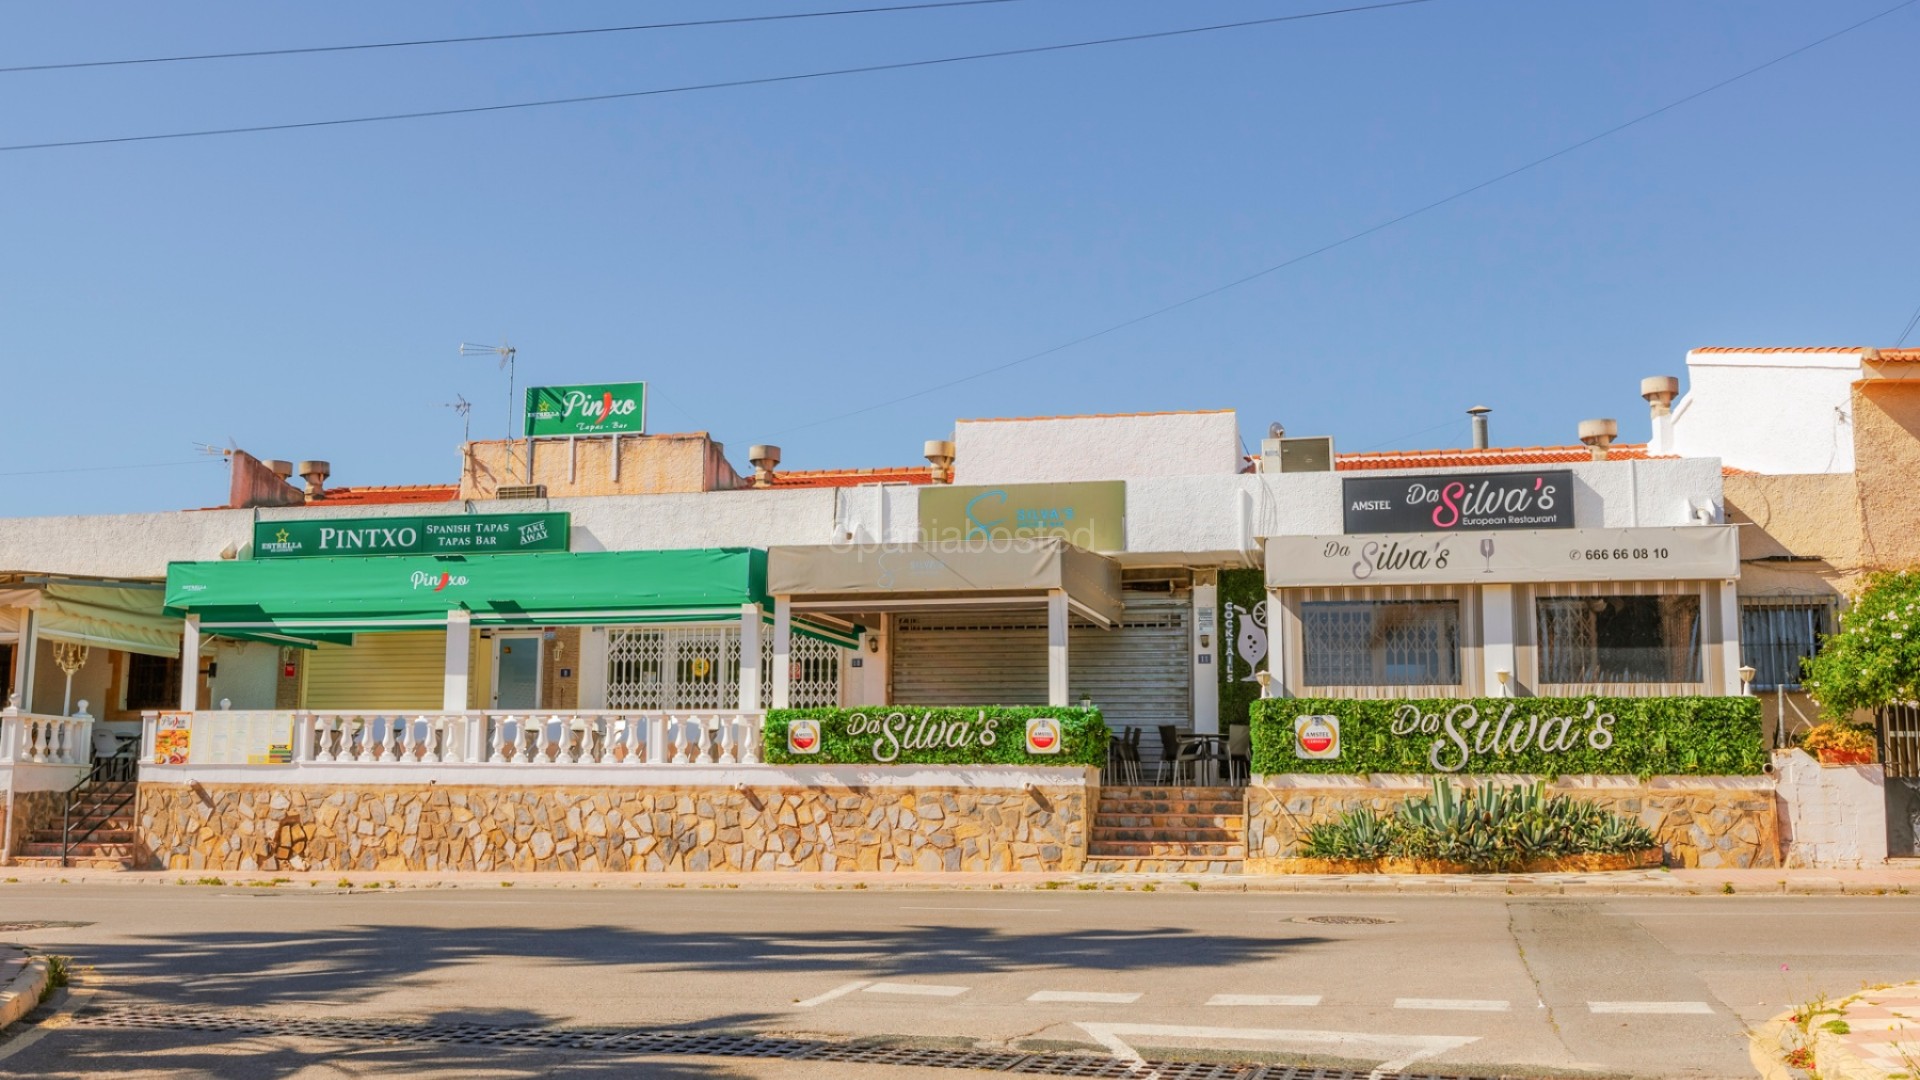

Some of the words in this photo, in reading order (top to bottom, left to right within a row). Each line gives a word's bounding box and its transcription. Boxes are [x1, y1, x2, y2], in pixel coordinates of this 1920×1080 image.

[576, 422, 603, 432] Tapas
[612, 421, 628, 430] Bar
[1351, 501, 1391, 511] AMSTEL
[1406, 483, 1440, 505] Da
[1432, 478, 1556, 527] Silva's
[1463, 517, 1507, 527] European
[1508, 514, 1557, 524] Restaurant
[426, 524, 471, 534] SPANISH
[475, 523, 510, 533] TAPAS
[518, 522, 546, 536] TAKE
[319, 527, 417, 549] PINTXO
[438, 537, 471, 546] TAPAS
[475, 536, 497, 545] BAR
[520, 530, 549, 545] AWAY
[1323, 541, 1351, 558] Da
[1352, 541, 1450, 580] Silva's
[1585, 549, 1609, 560] 666
[1613, 548, 1629, 560] 66
[1632, 548, 1649, 559] 08
[1653, 547, 1669, 559] 10
[1224, 601, 1234, 683] COCKTAILS
[847, 713, 881, 736] Da
[872, 710, 998, 762] Silva's
[1391, 704, 1440, 735] Da
[1431, 700, 1616, 772] Silva's
